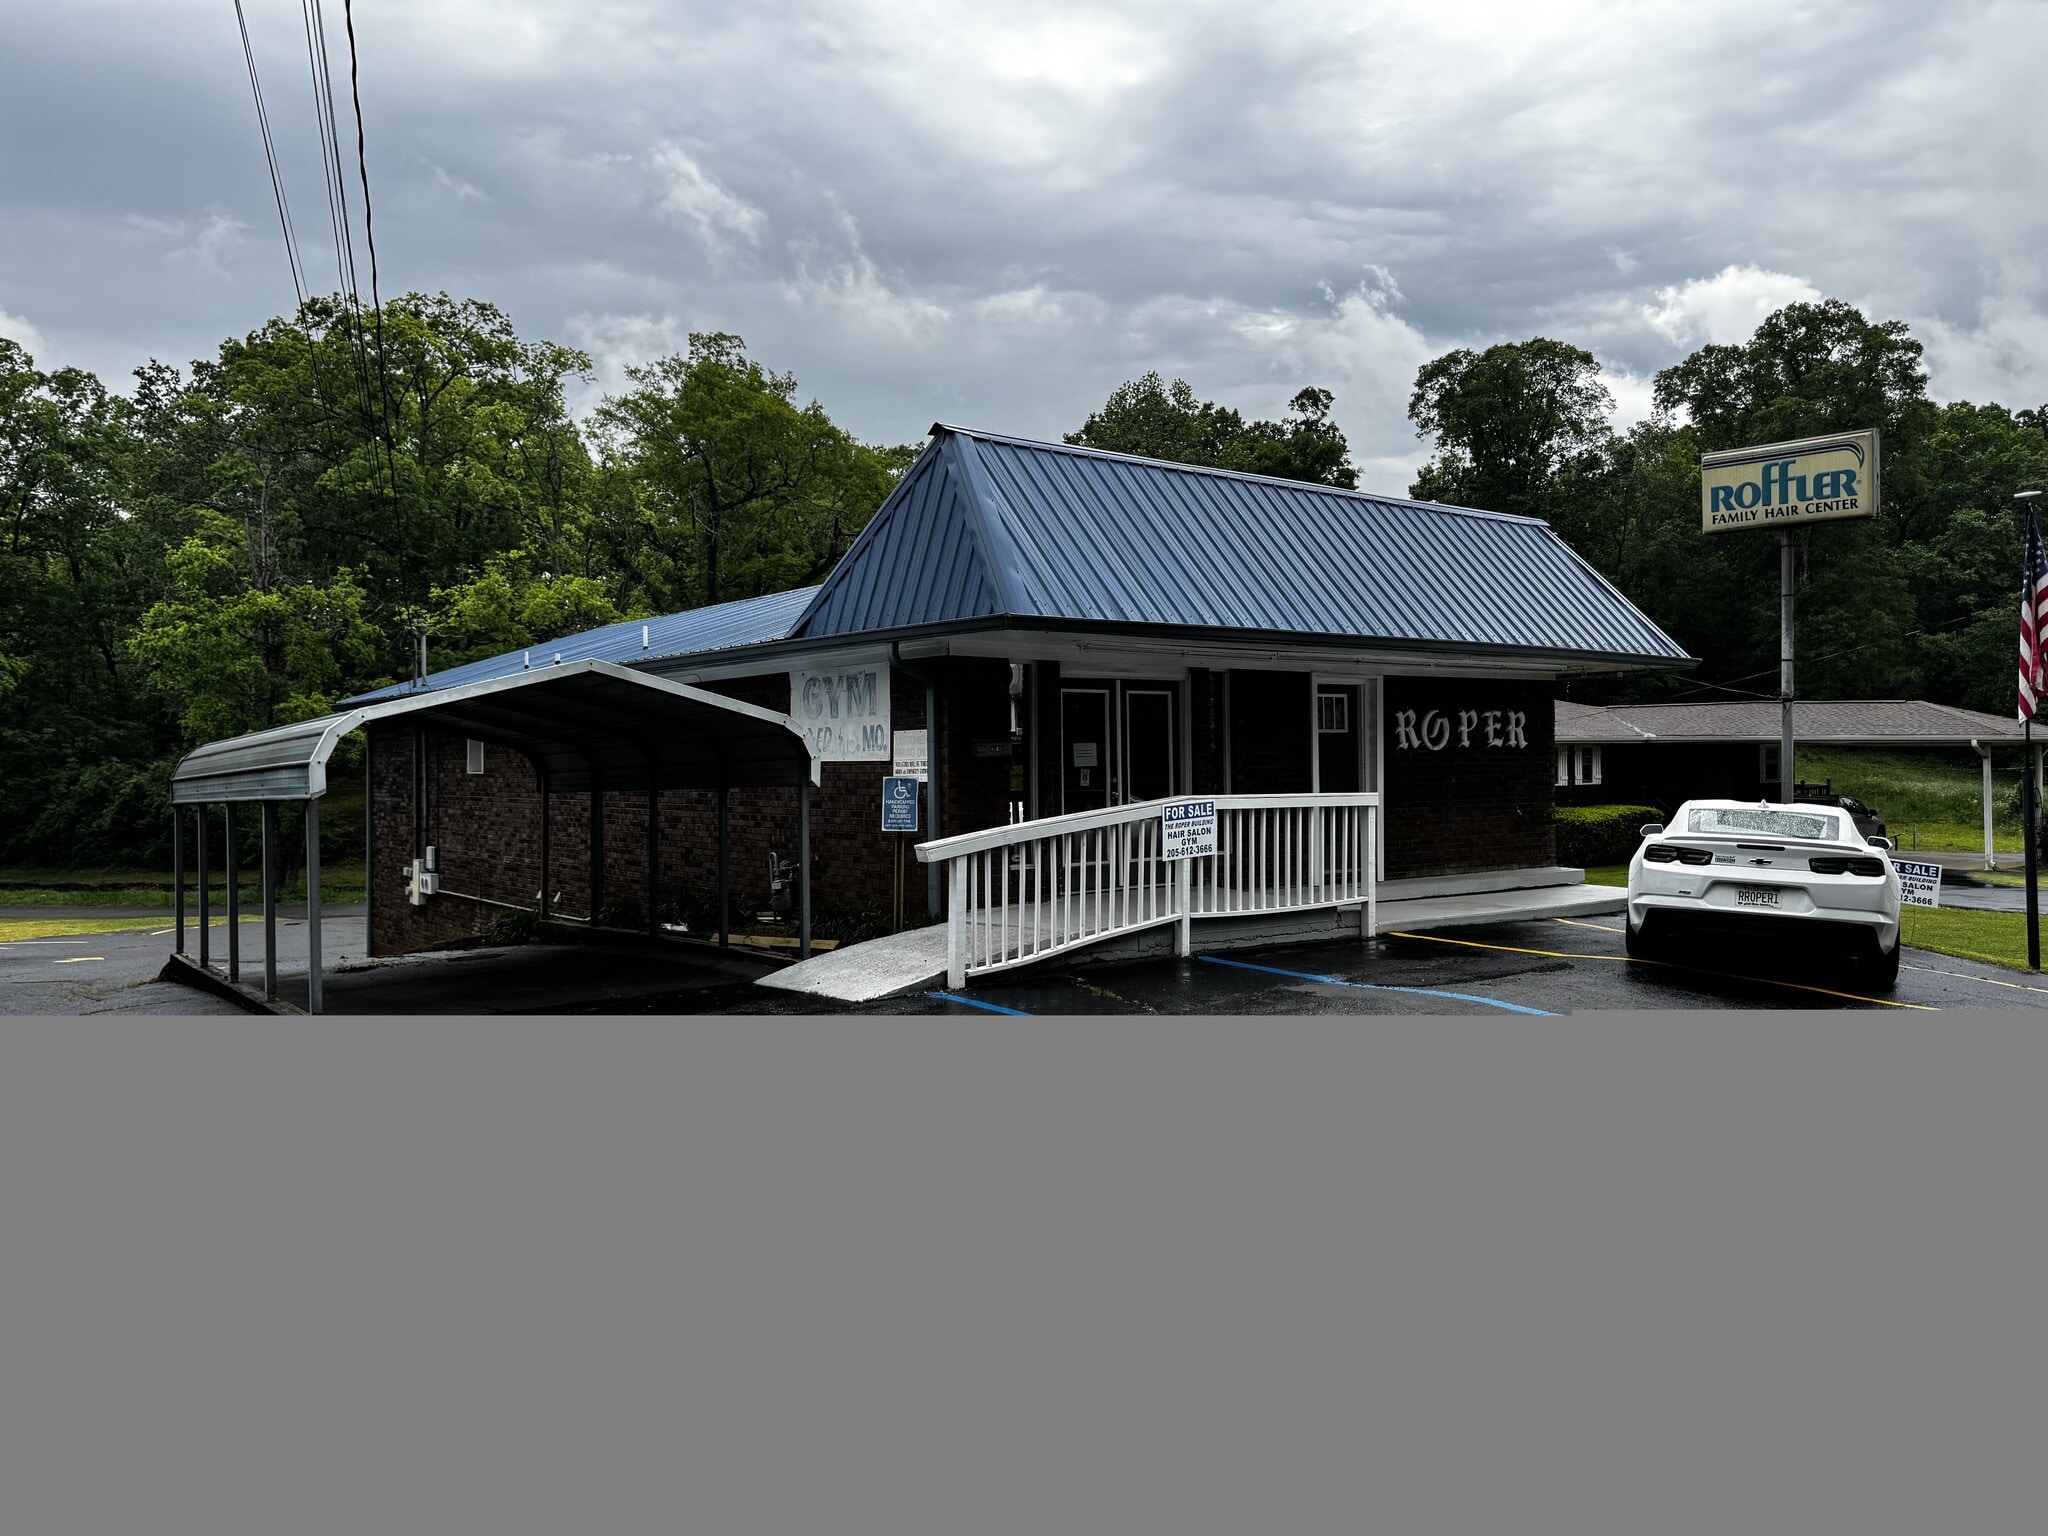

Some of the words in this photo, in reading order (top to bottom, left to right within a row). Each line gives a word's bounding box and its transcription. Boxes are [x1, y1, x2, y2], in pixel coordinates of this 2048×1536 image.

[1712, 509, 1758, 525] FAMILY
[1764, 504, 1799, 519] HAIR
[1805, 498, 1859, 514] CENTER
[803, 671, 877, 719] GYM
[1394, 709, 1528, 750] ROPER
[862, 724, 887, 751] MO.
[1166, 806, 1185, 820] FOR
[1187, 804, 1213, 817] SALE
[1175, 821, 1191, 829] ROPER
[1191, 818, 1213, 826] BUILDING
[1167, 830, 1185, 839] HAIR
[1187, 827, 1211, 837] SALON
[1181, 837, 1198, 846] GYM
[1167, 844, 1212, 857] 205-612-3666
[1905, 864, 1937, 877] SALE
[1903, 882, 1933, 891] SALON
[1908, 876, 1937, 884] BUILDING
[1738, 890, 1779, 904] RROPER1
